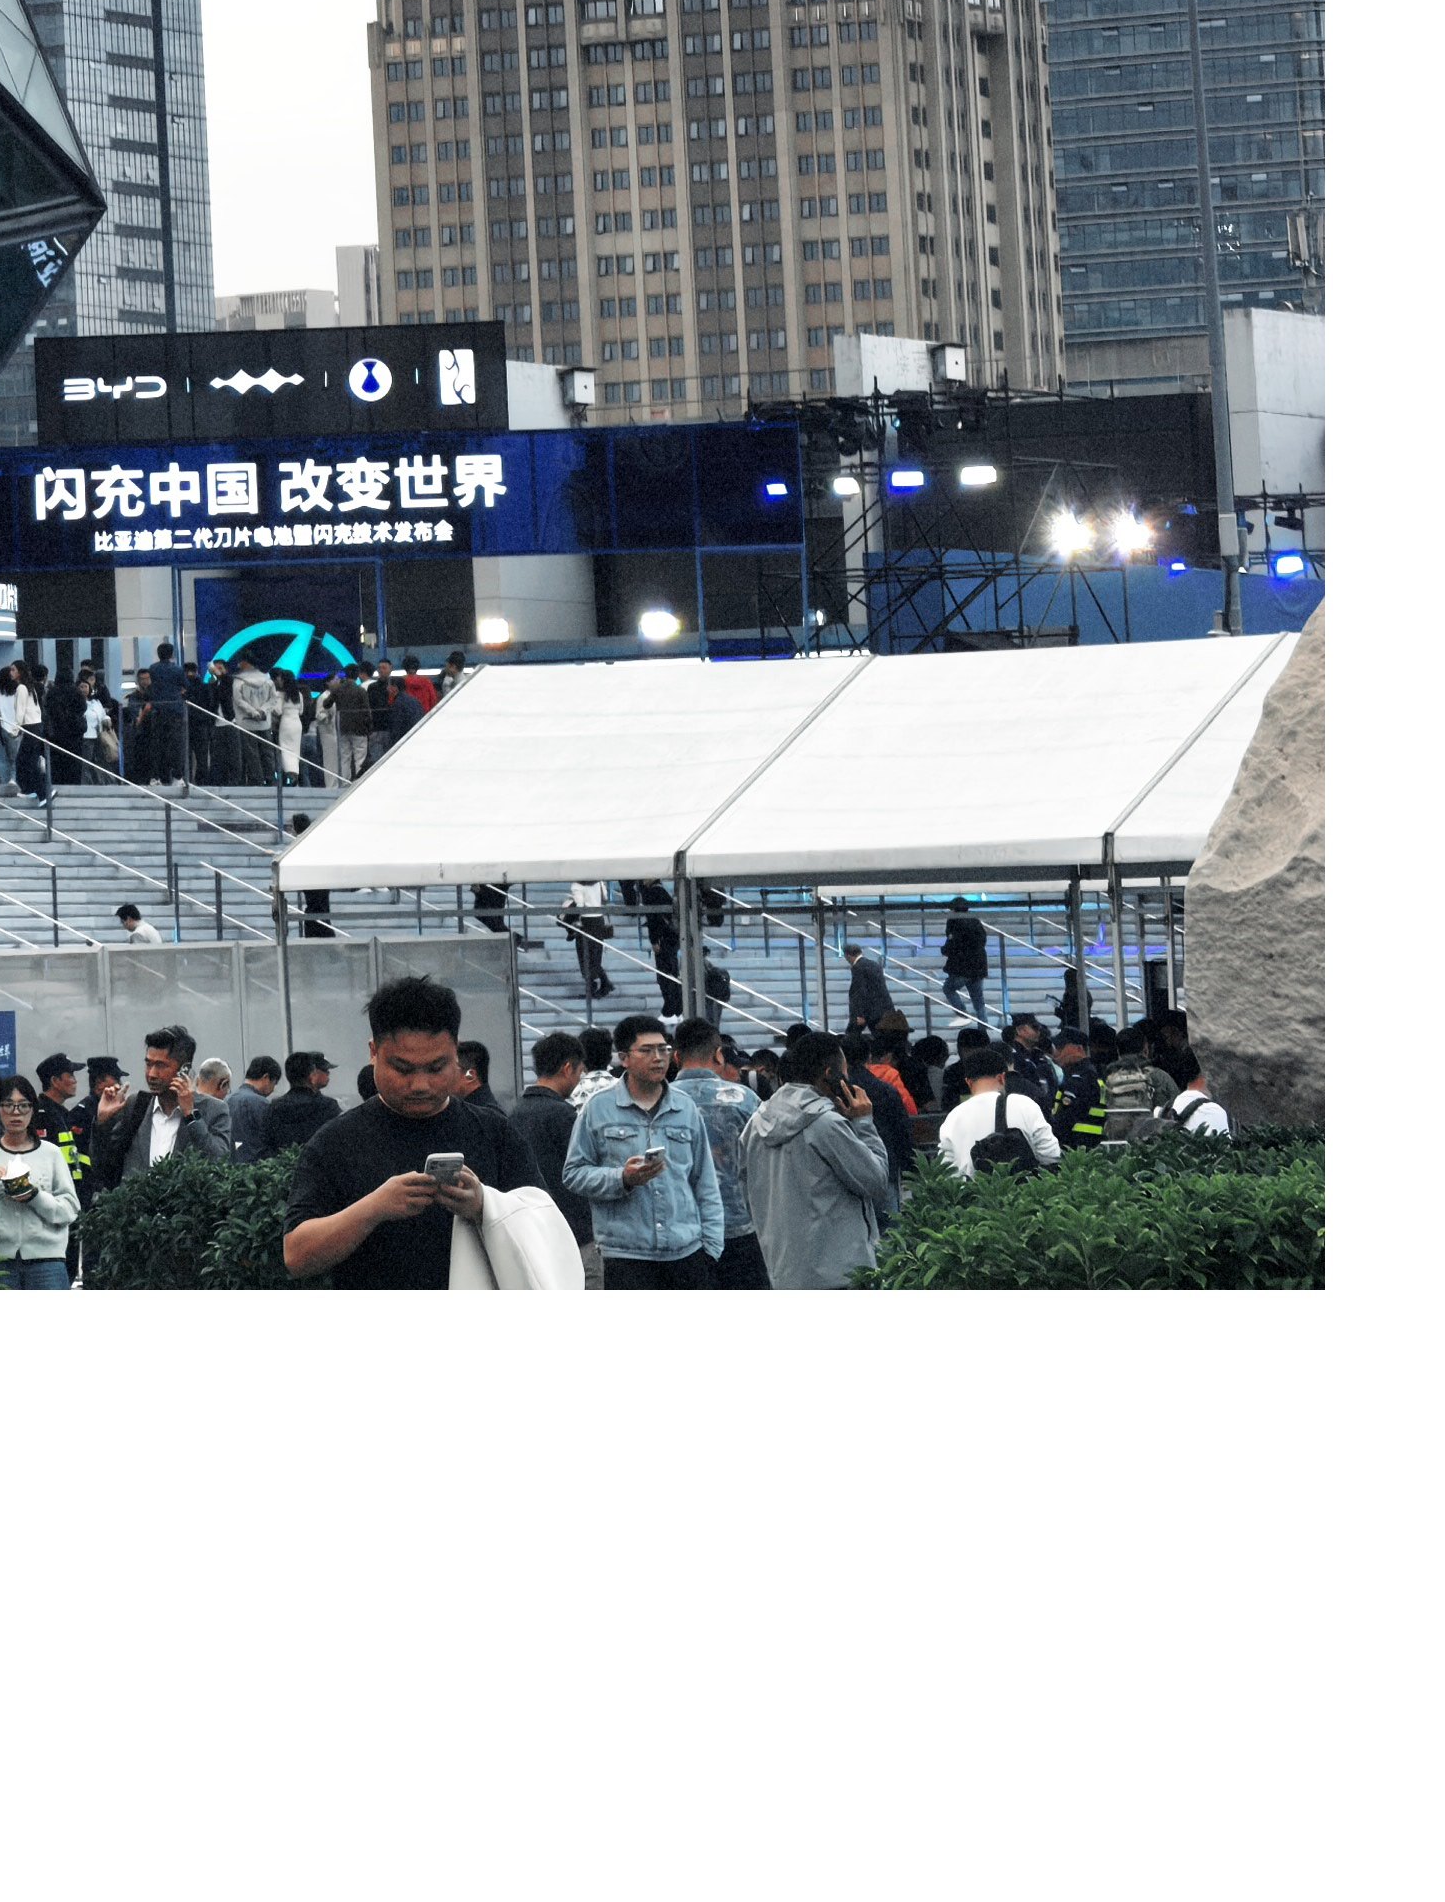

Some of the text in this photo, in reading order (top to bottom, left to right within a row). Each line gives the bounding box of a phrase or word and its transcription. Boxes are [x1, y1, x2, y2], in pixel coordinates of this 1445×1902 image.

[63, 375, 168, 401] BYD
[34, 453, 508, 521] 闪充中国 改变世界
